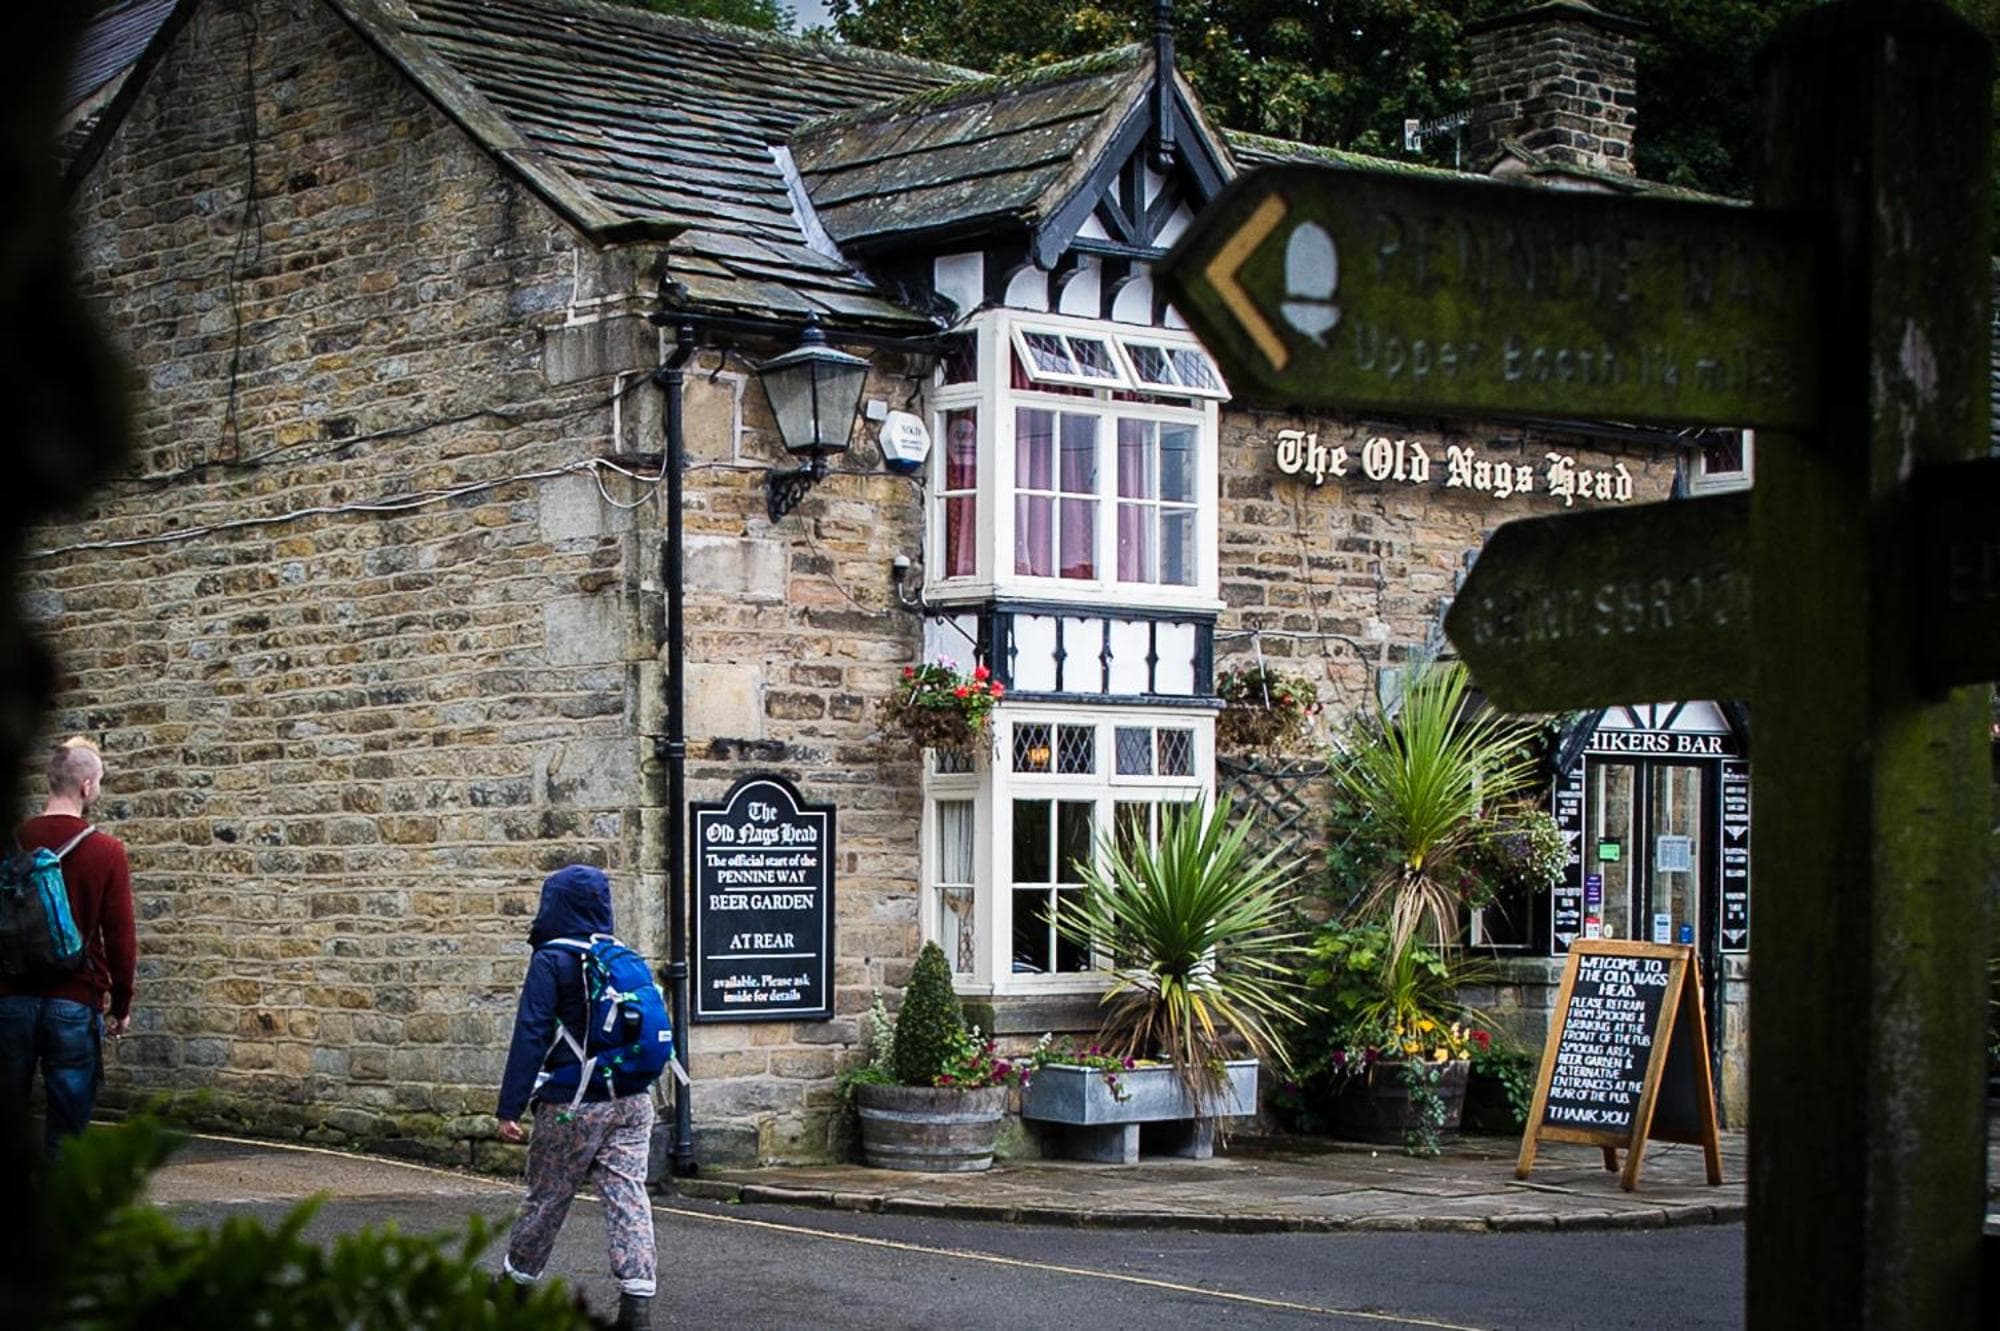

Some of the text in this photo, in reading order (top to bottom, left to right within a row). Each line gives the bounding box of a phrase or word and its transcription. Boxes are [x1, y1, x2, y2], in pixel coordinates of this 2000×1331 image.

[1275, 429, 1633, 506] The Old Nags Head
[1585, 732, 1723, 754] HIKERS BAR
[748, 802, 778, 823] The
[706, 822, 817, 846] Old Nags Head
[705, 854, 726, 867] The
[728, 854, 764, 867] official
[789, 854, 800, 867] of
[800, 853, 817, 867] the
[718, 870, 806, 883] PENNINE WAY
[709, 894, 814, 911] BEER GARDEN
[729, 933, 795, 949] AT REAR
[1580, 956, 1662, 973] WELCOME TO
[761, 974, 792, 987] Please
[1578, 968, 1669, 987] THE OLD NAGS
[753, 989, 769, 1001] for
[1598, 983, 1636, 998] HEAD
[1570, 996, 1603, 1009] PLEASE
[1613, 1022, 1625, 1033] AT
[1562, 1030, 1596, 1041] FRONT
[1598, 1033, 1612, 1043] OF
[1558, 1053, 1582, 1065] BEER
[1584, 1055, 1623, 1069] GARDEN
[1555, 1065, 1621, 1080] ALTERNATIVE
[1548, 1105, 1630, 1126] THANK YOU
